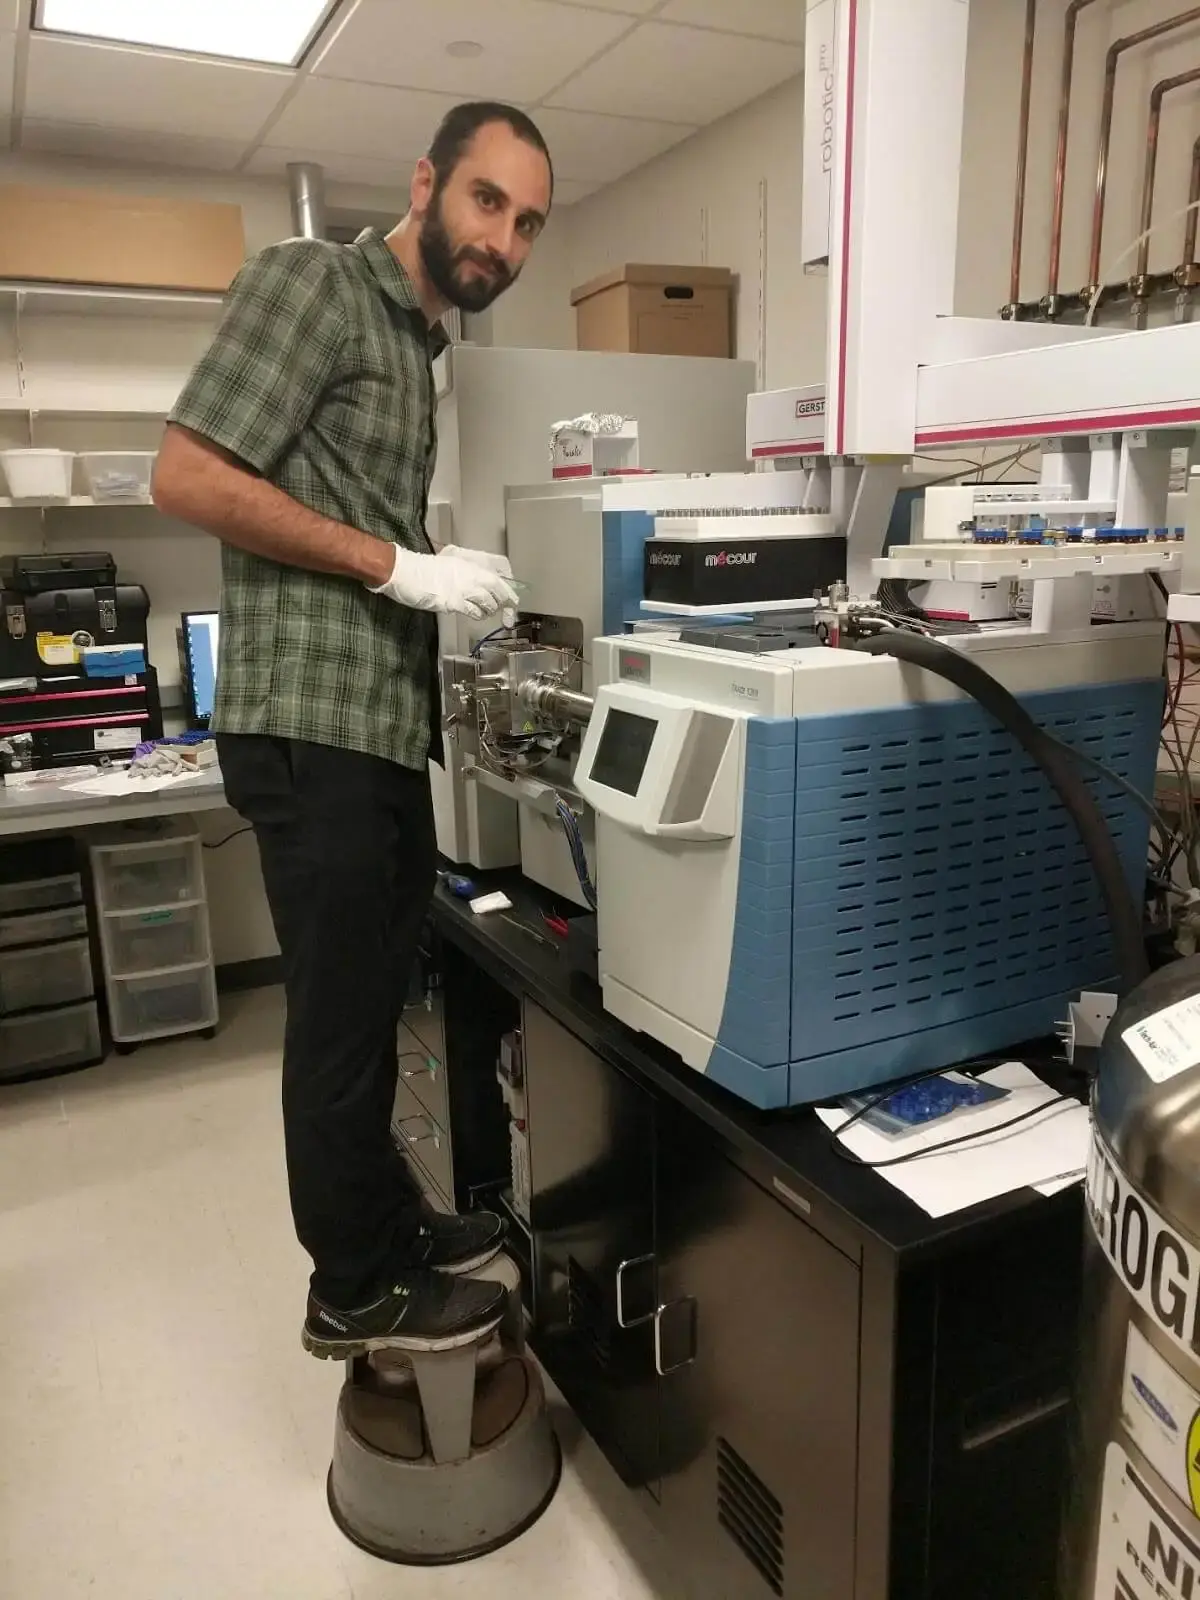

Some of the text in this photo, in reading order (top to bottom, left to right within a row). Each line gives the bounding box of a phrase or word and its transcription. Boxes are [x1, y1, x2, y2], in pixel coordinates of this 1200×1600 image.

[798, 401, 825, 413] GERST
[320, 1310, 349, 1333] Reebok
[1147, 1520, 1200, 1600] NI
